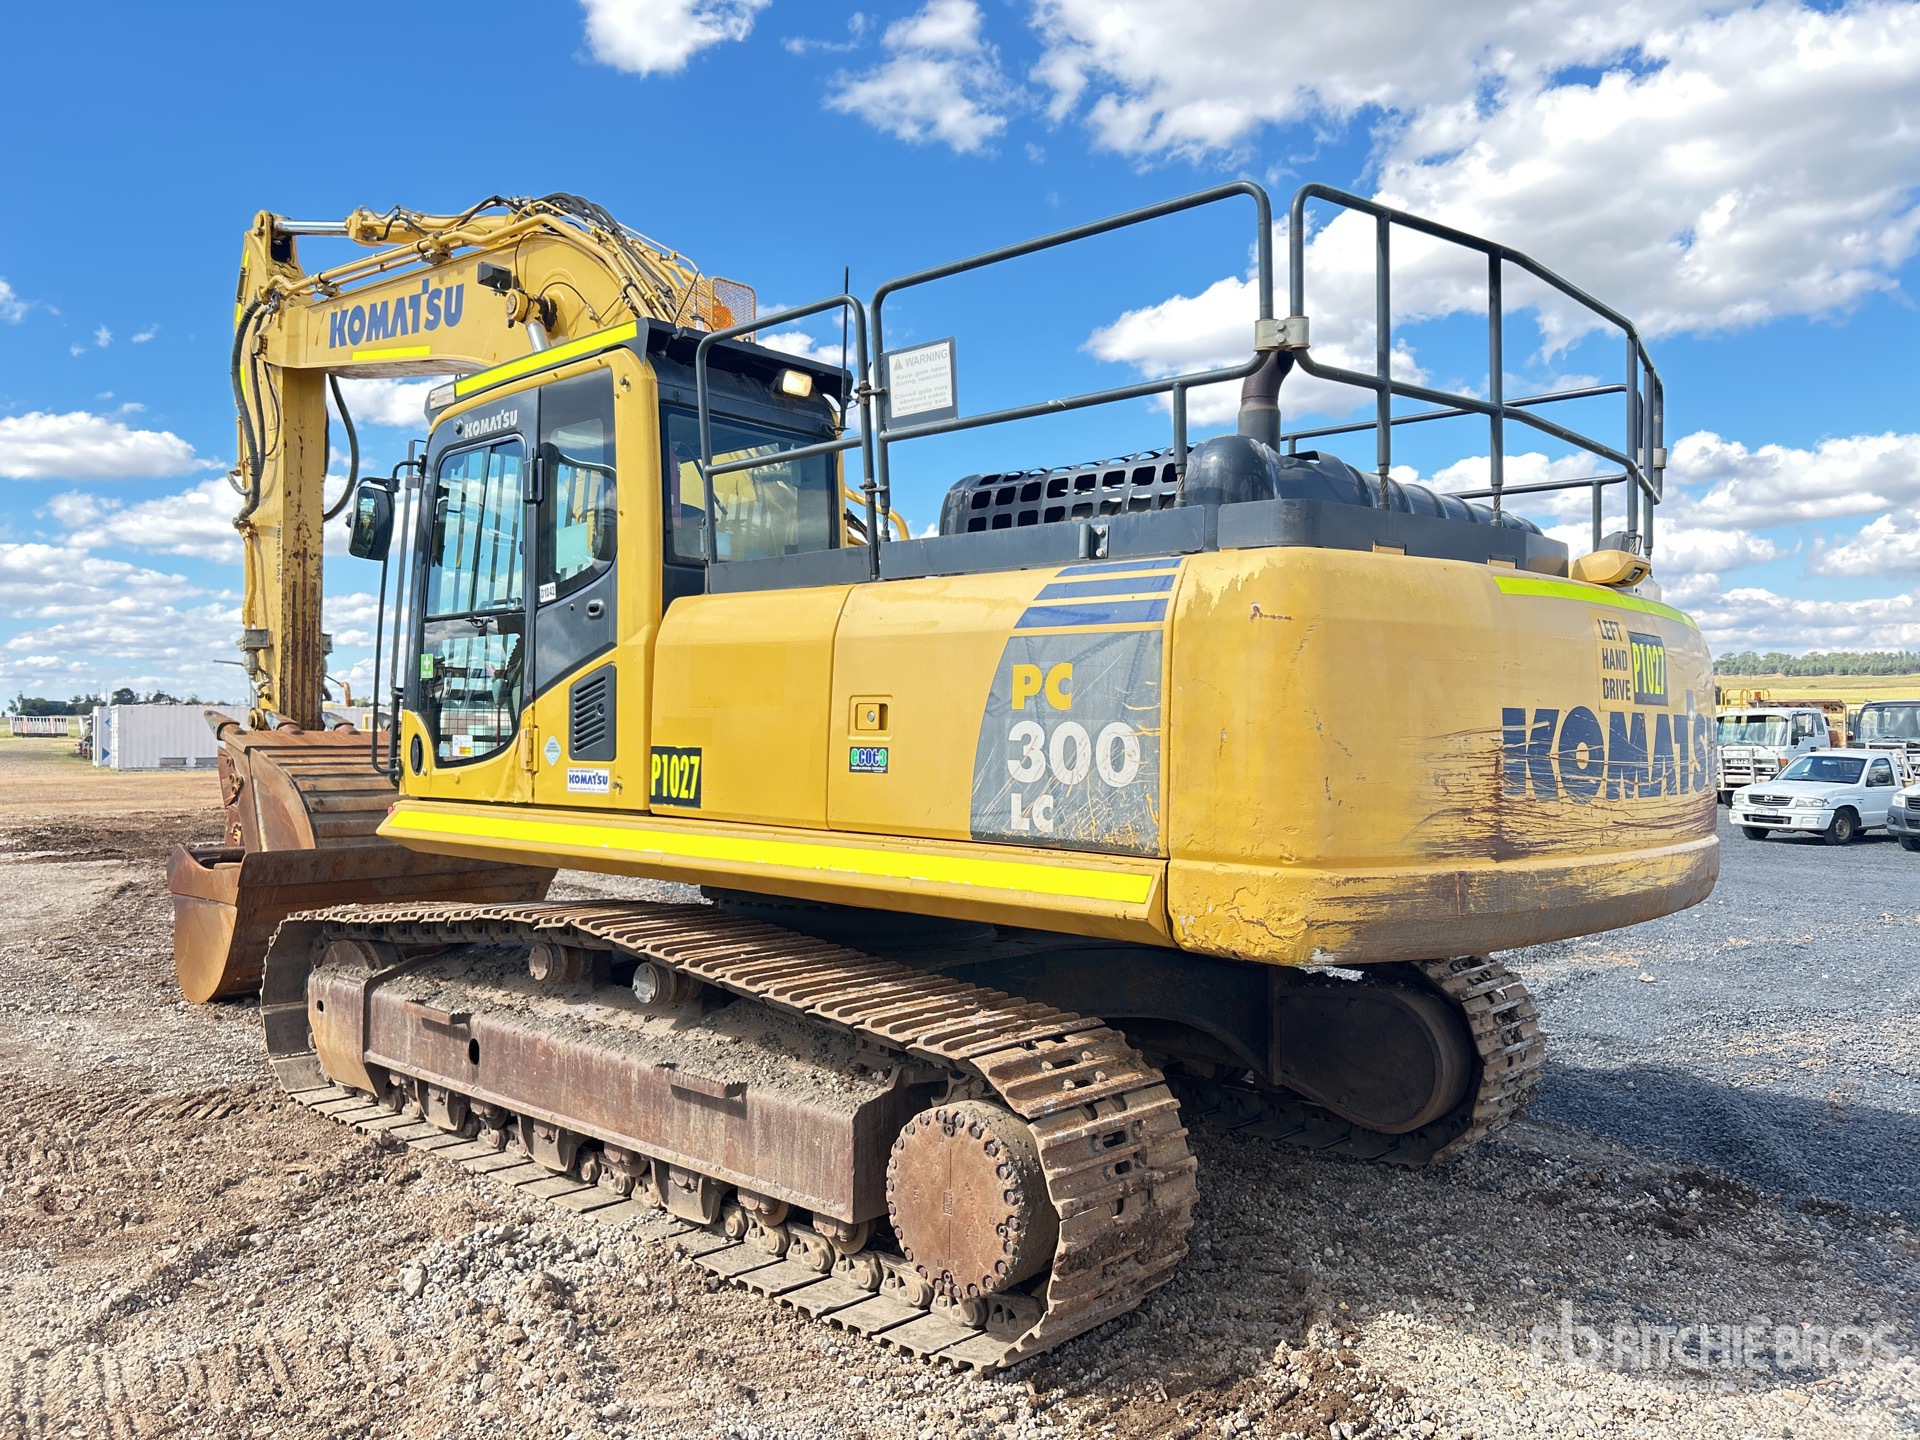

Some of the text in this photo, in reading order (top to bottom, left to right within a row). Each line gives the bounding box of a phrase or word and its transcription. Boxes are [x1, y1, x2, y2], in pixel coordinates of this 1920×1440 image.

[329, 278, 464, 349] KOMATSU
[905, 348, 948, 368] WARNING
[896, 365, 947, 381] Keep gate open
[917, 371, 949, 383] operation
[894, 384, 948, 400] Closed gate may
[899, 391, 946, 405] obstruct cabin
[897, 400, 933, 412] emergency
[464, 408, 518, 439] KOMATSU
[1597, 619, 1623, 641] LEFT
[1602, 647, 1628, 671] HAND
[1631, 642, 1664, 695] P1027
[1011, 663, 1073, 711] PC
[1602, 677, 1631, 701] DRIVE
[851, 748, 887, 766] ecot3
[1007, 720, 1141, 788] 300
[568, 772, 608, 785] KOMATSU
[650, 753, 701, 799] P1027
[1010, 793, 1054, 833] LC
